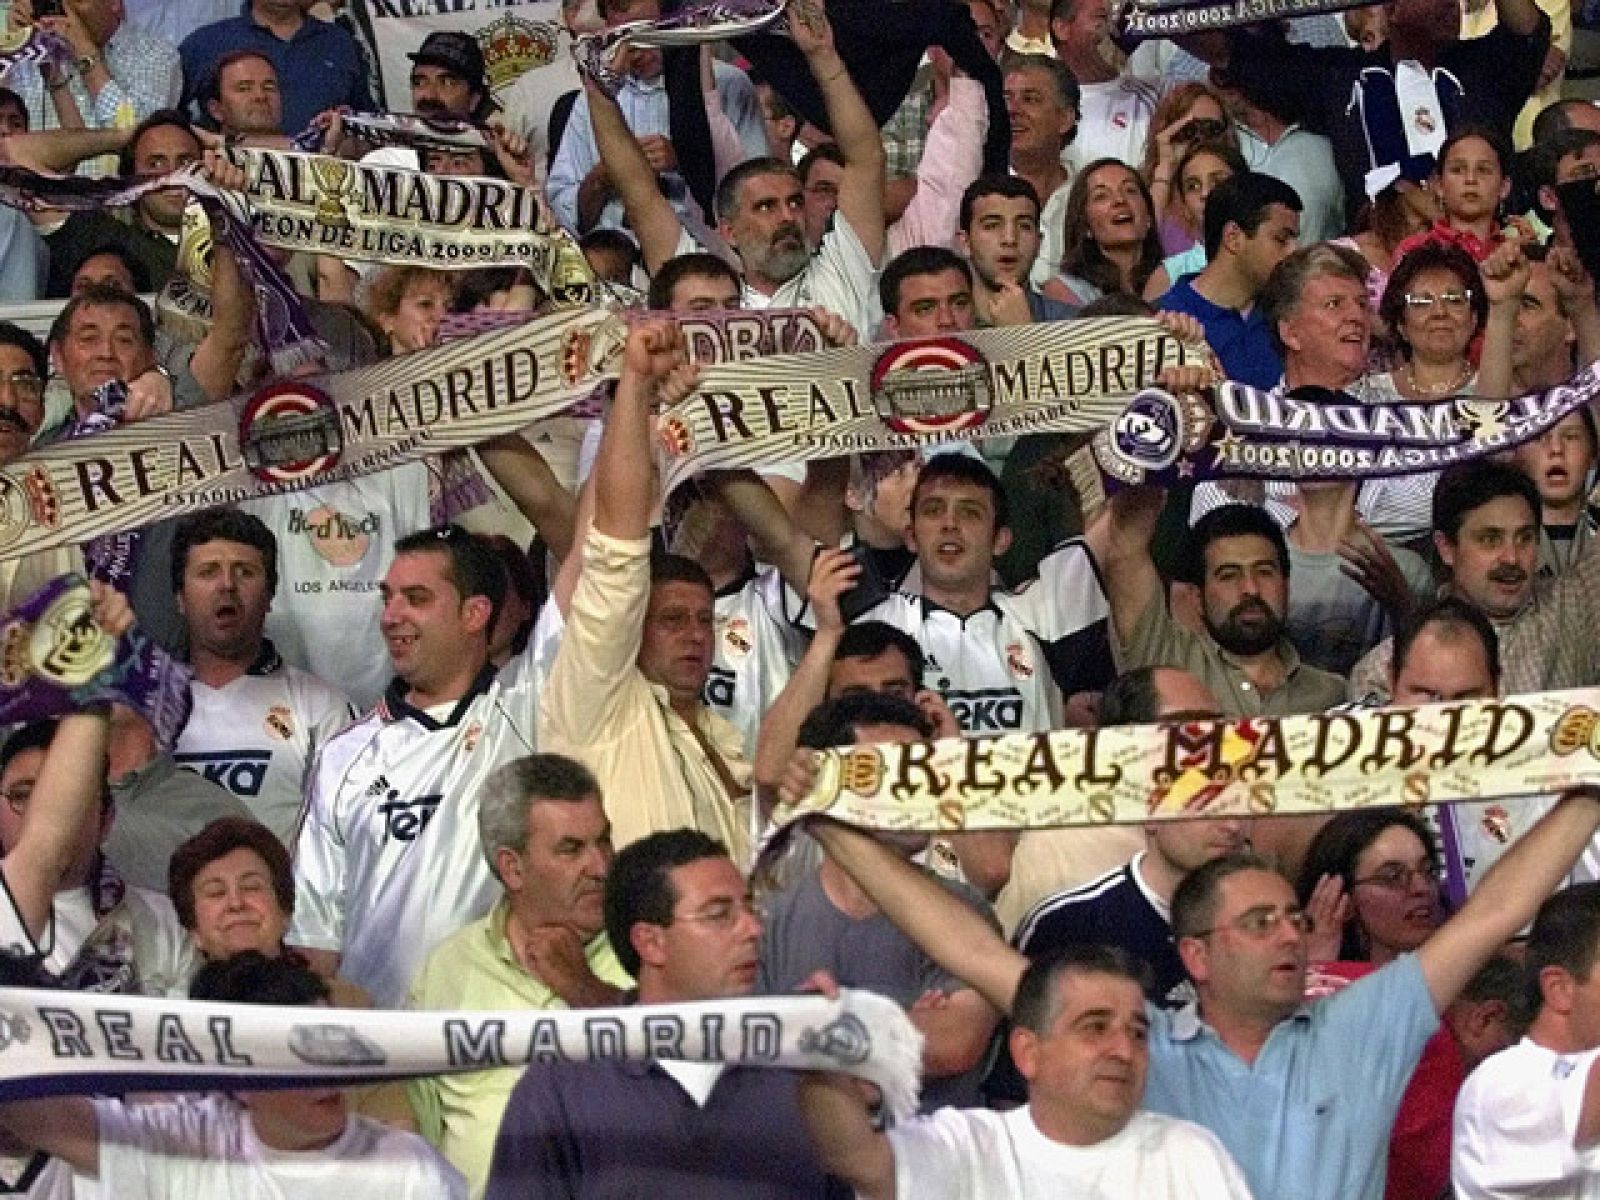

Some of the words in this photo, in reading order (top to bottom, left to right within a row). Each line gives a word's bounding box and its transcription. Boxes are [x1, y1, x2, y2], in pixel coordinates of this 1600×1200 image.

[362, 229, 422, 255] LIGA
[74, 433, 246, 511] REAL
[342, 348, 538, 437] MADRID
[700, 379, 873, 442] REAL
[294, 581, 322, 593] LOS
[945, 686, 1023, 731] eka
[891, 730, 1123, 801] REAL
[1153, 703, 1535, 784] MADRID
[39, 1006, 254, 1067] REAL
[444, 1012, 783, 1067] MADRID
